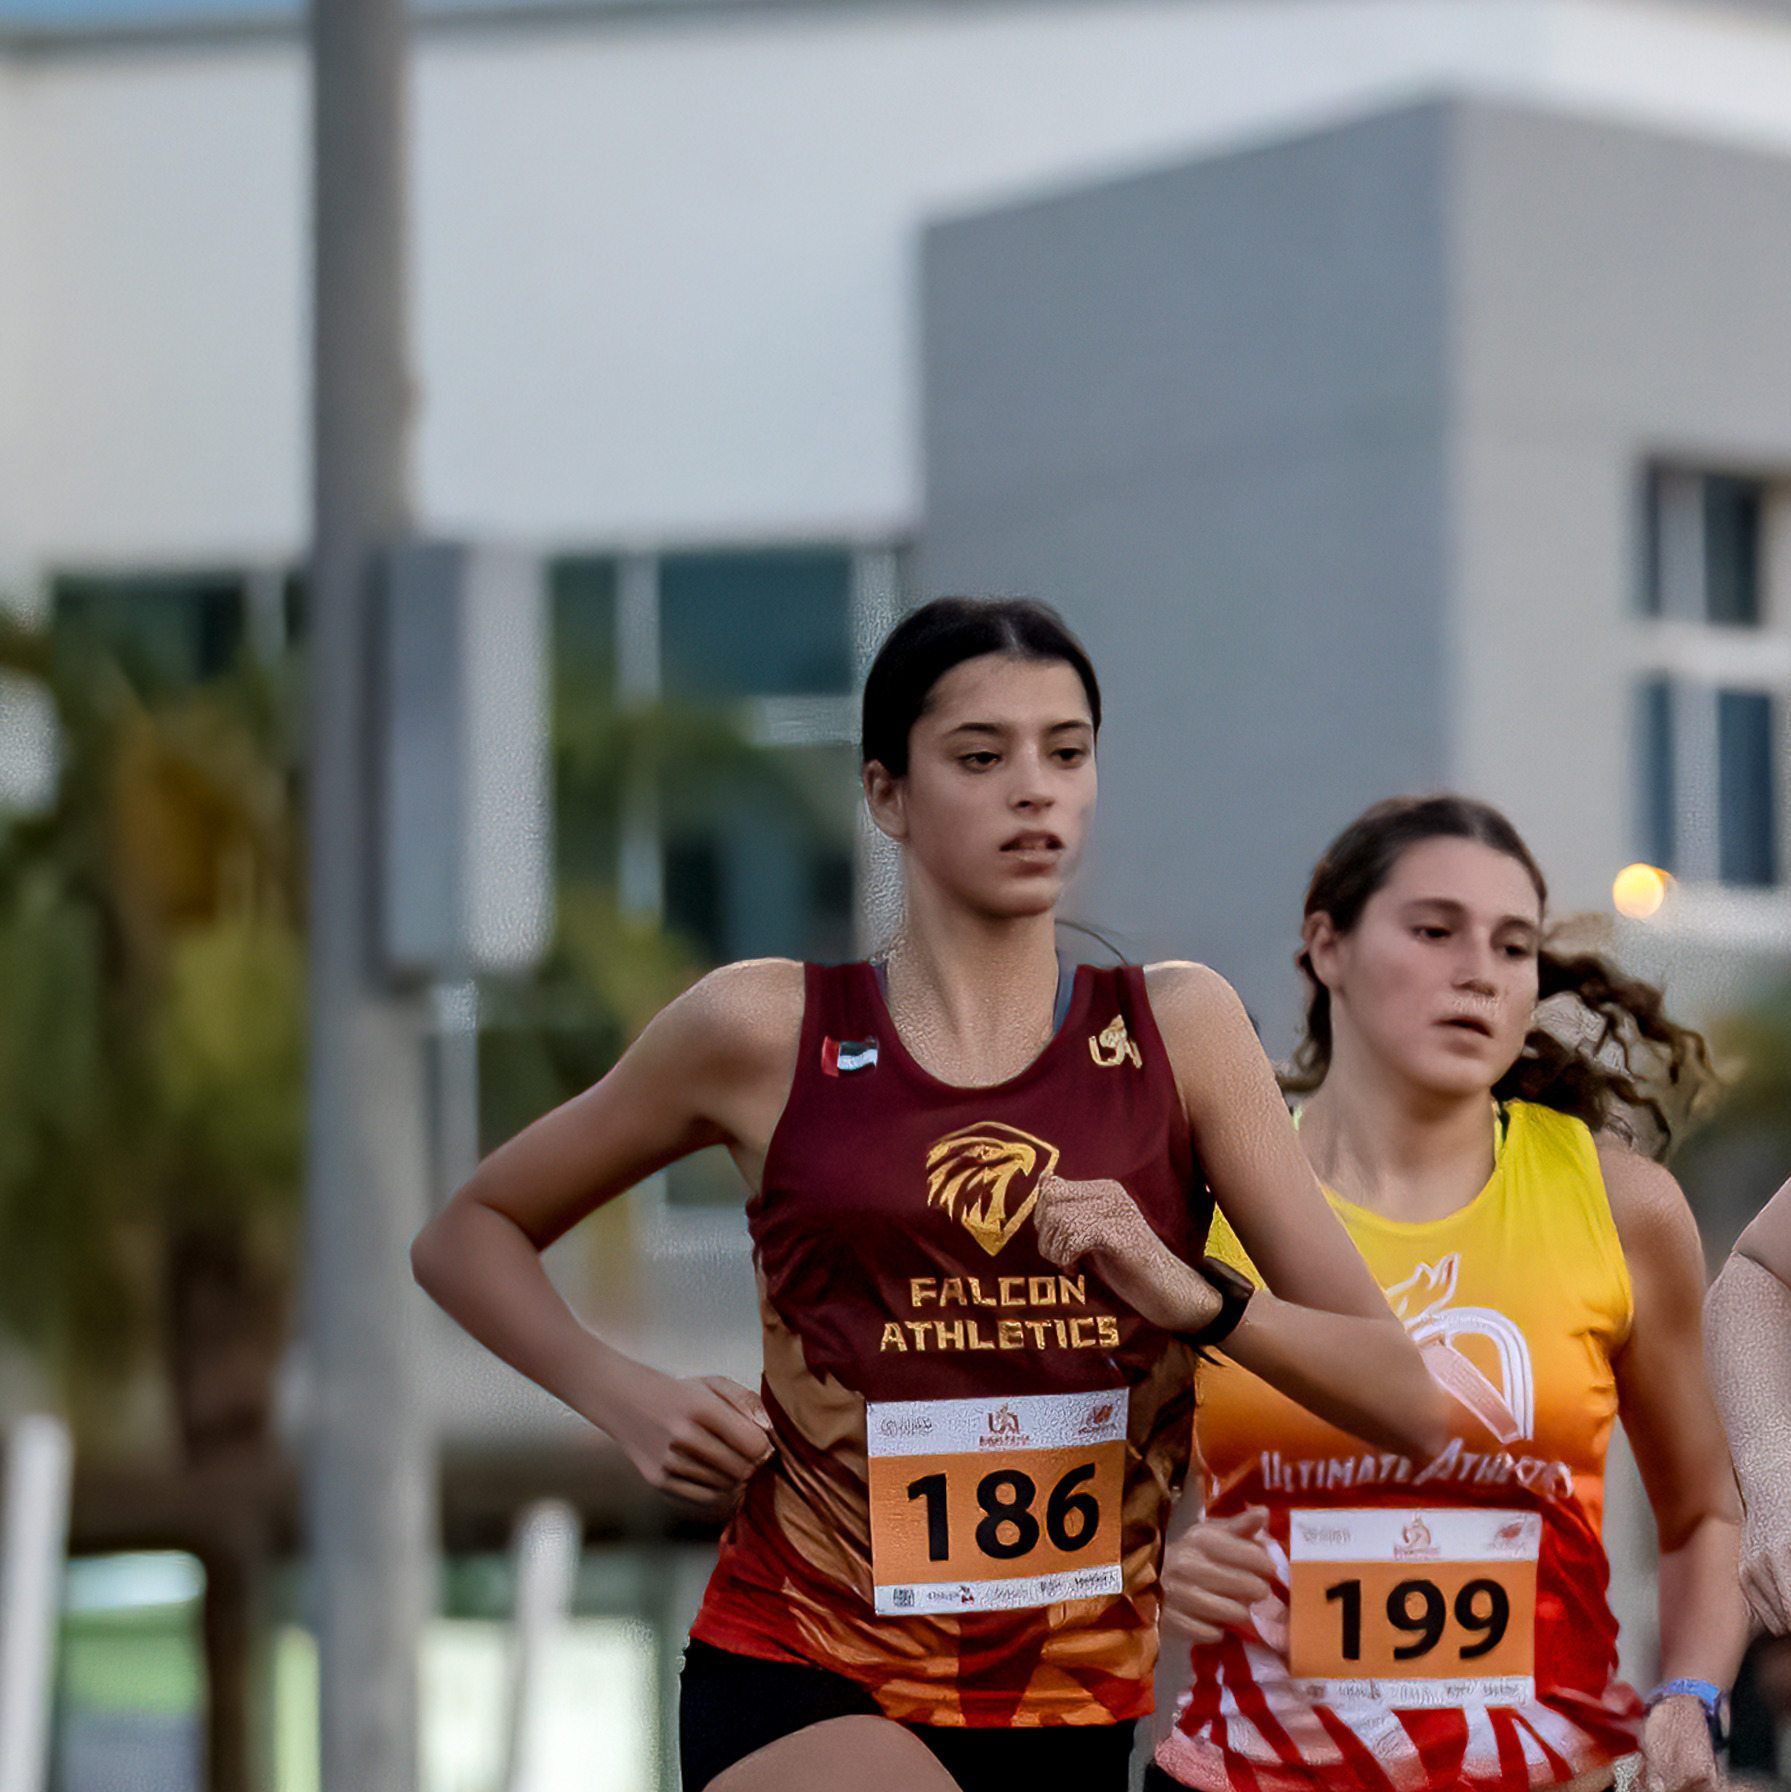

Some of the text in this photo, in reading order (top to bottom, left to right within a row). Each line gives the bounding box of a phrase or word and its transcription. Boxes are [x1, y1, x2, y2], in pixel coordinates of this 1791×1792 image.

[909, 1274, 1086, 1307] FALCON
[879, 1315, 1120, 1352] ATHLETICS
[906, 1461, 1100, 1562] 186
[1325, 1578, 1510, 1661] 199
